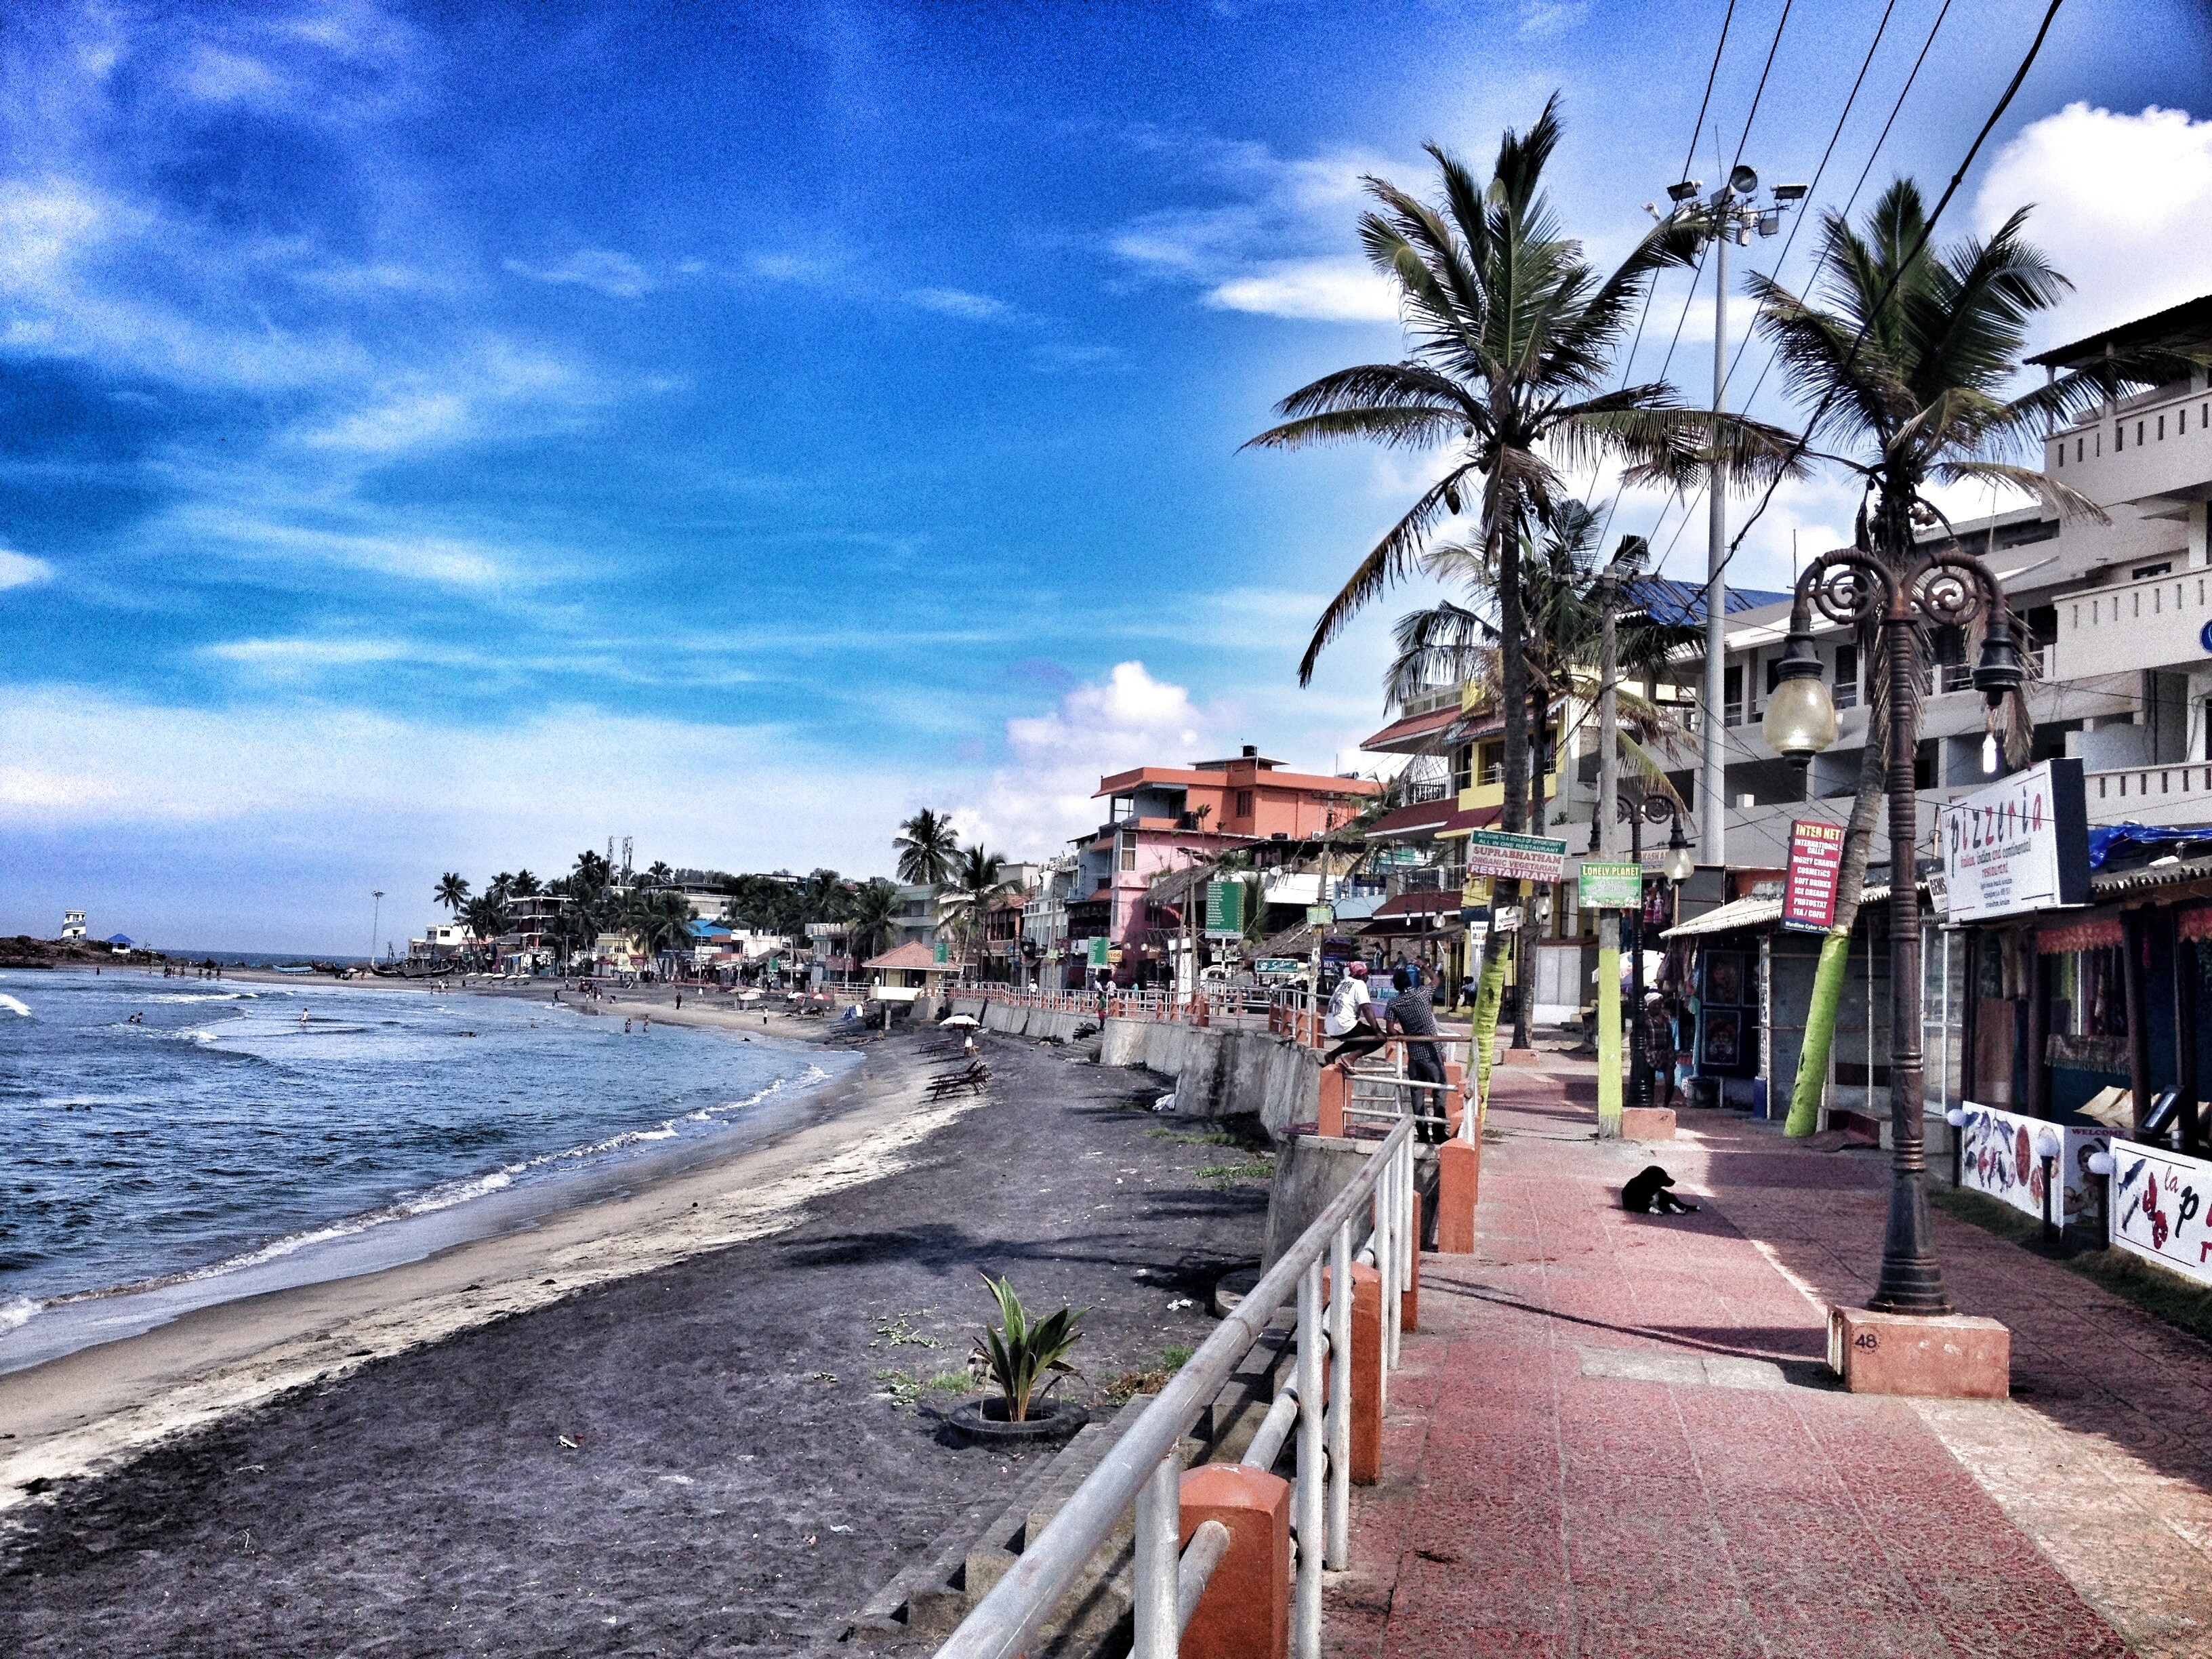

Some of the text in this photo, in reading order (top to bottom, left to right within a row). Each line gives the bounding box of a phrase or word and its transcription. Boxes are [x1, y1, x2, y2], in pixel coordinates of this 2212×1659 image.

[1796, 824, 1841, 841] INTER NET
[1951, 786, 2042, 878] pizzeria
[1515, 843, 1559, 853] RESTAURANT
[1473, 846, 1561, 864] SUPRABHATHAM
[1793, 855, 1837, 868] MONEY CHANGE
[1472, 856, 1559, 872] ORGANIC VEGETARIAN
[1582, 865, 1639, 876] LONELY PLANET
[1471, 864, 1558, 883] RESTAURANT
[1797, 866, 1831, 878] COSMETICS
[1794, 876, 1832, 889] SOFT DRINKS
[1794, 886, 1829, 899] ICE CREAMS
[1793, 897, 1828, 909] PHOTOSTAT
[1793, 907, 1803, 916] TEA
[2165, 1166, 2179, 1193] la
[1855, 1333, 1877, 1349] 48
